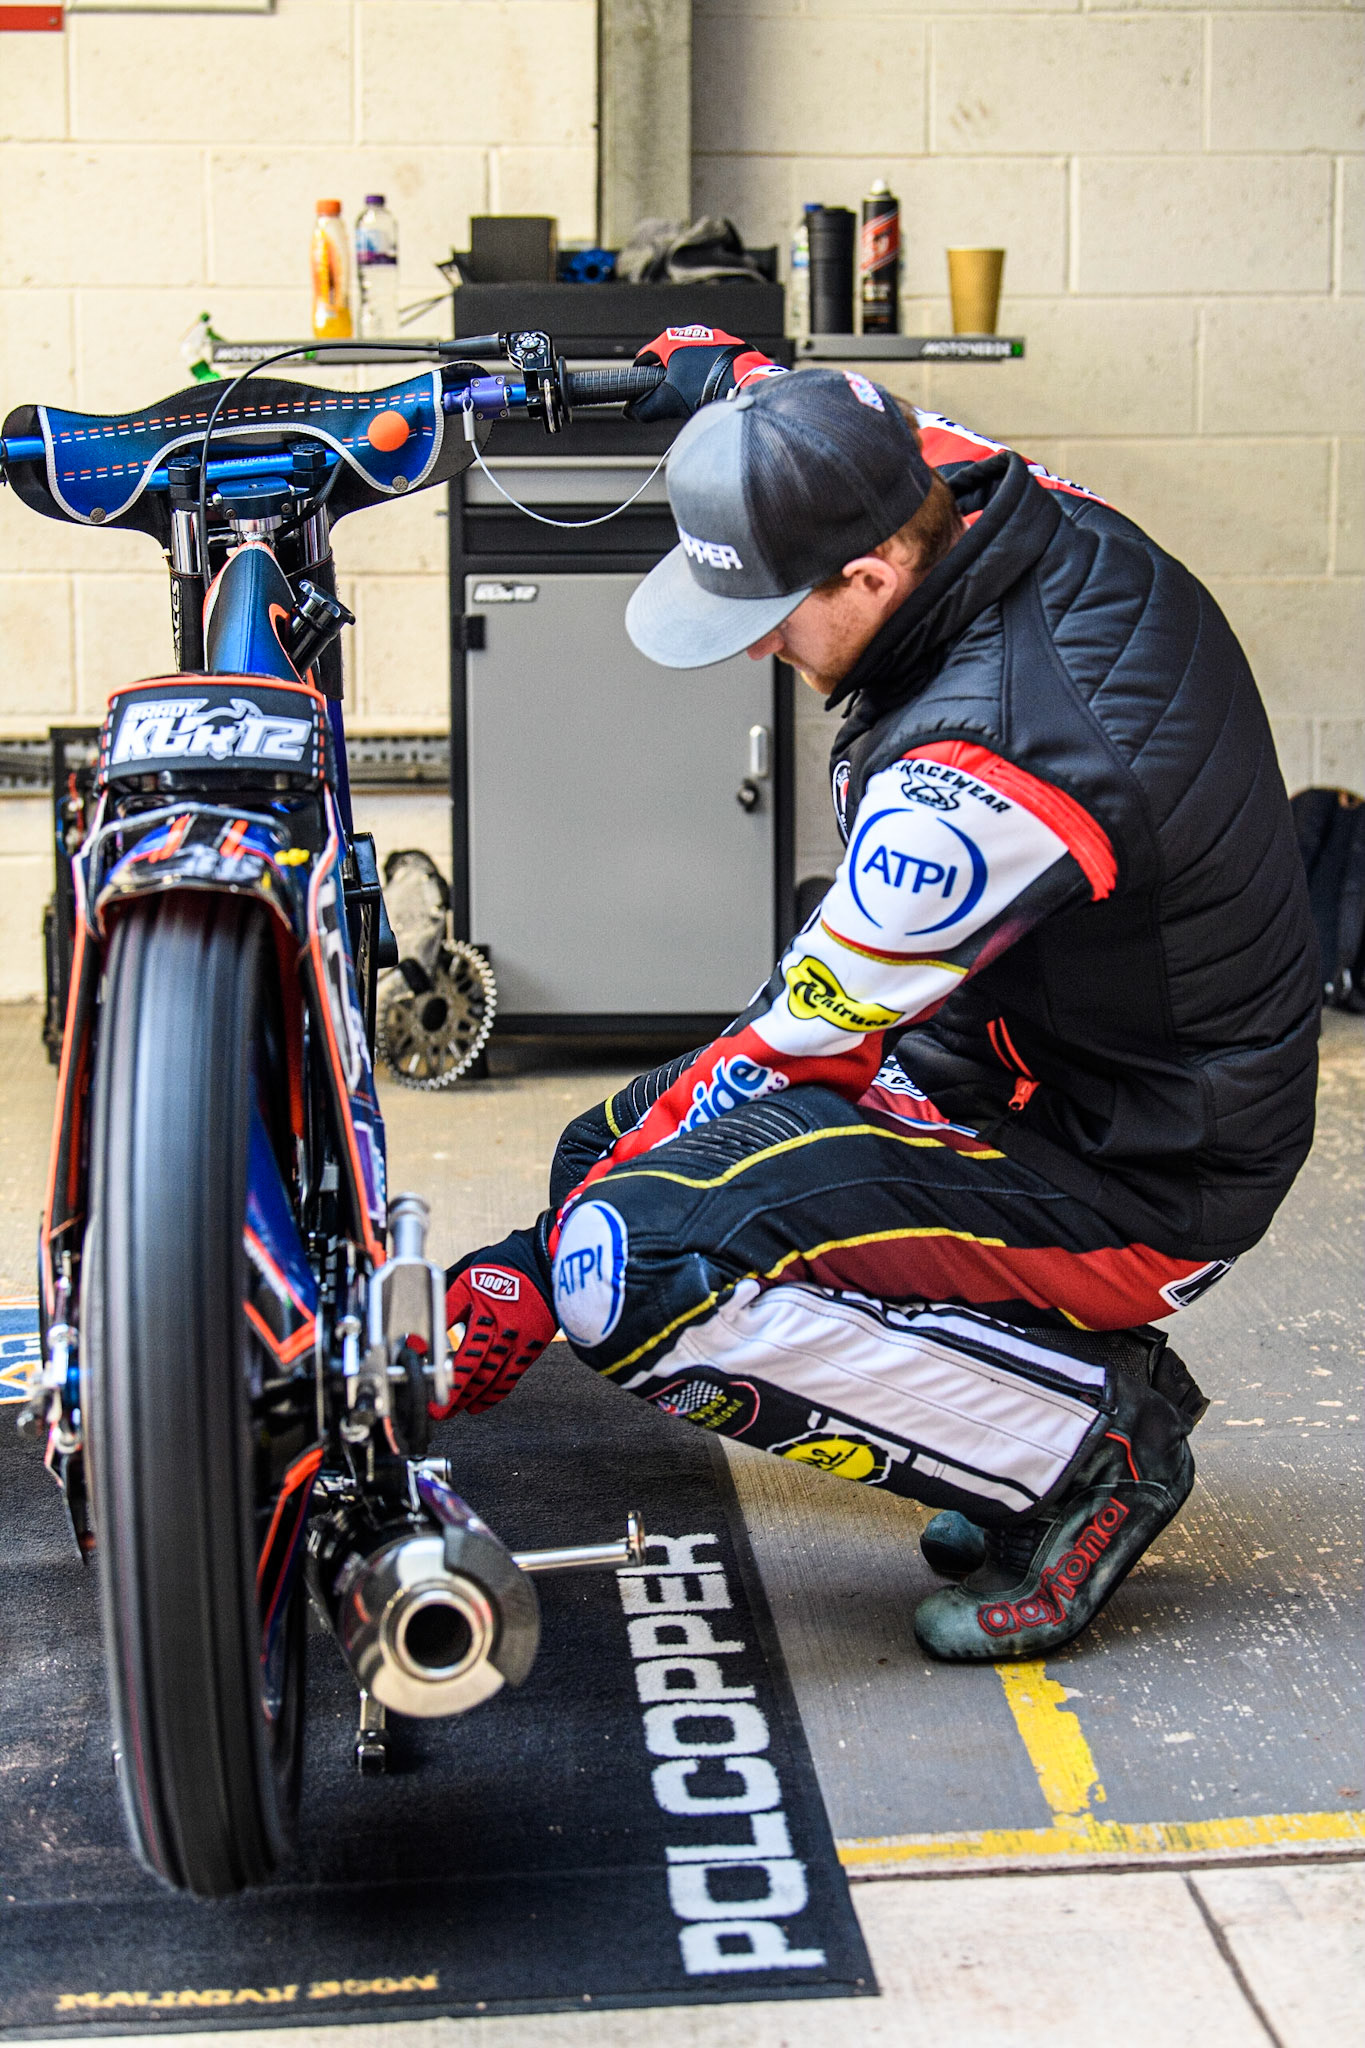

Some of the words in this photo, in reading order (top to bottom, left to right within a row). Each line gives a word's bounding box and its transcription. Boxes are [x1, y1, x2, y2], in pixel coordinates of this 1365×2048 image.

[678, 526, 744, 570] PPER
[110, 715, 312, 764] KURTZ
[862, 845, 957, 898] ATPI
[478, 1273, 514, 1296] 100%
[558, 1244, 603, 1301] ATPI
[615, 1533, 828, 1975] POLCOPPER
